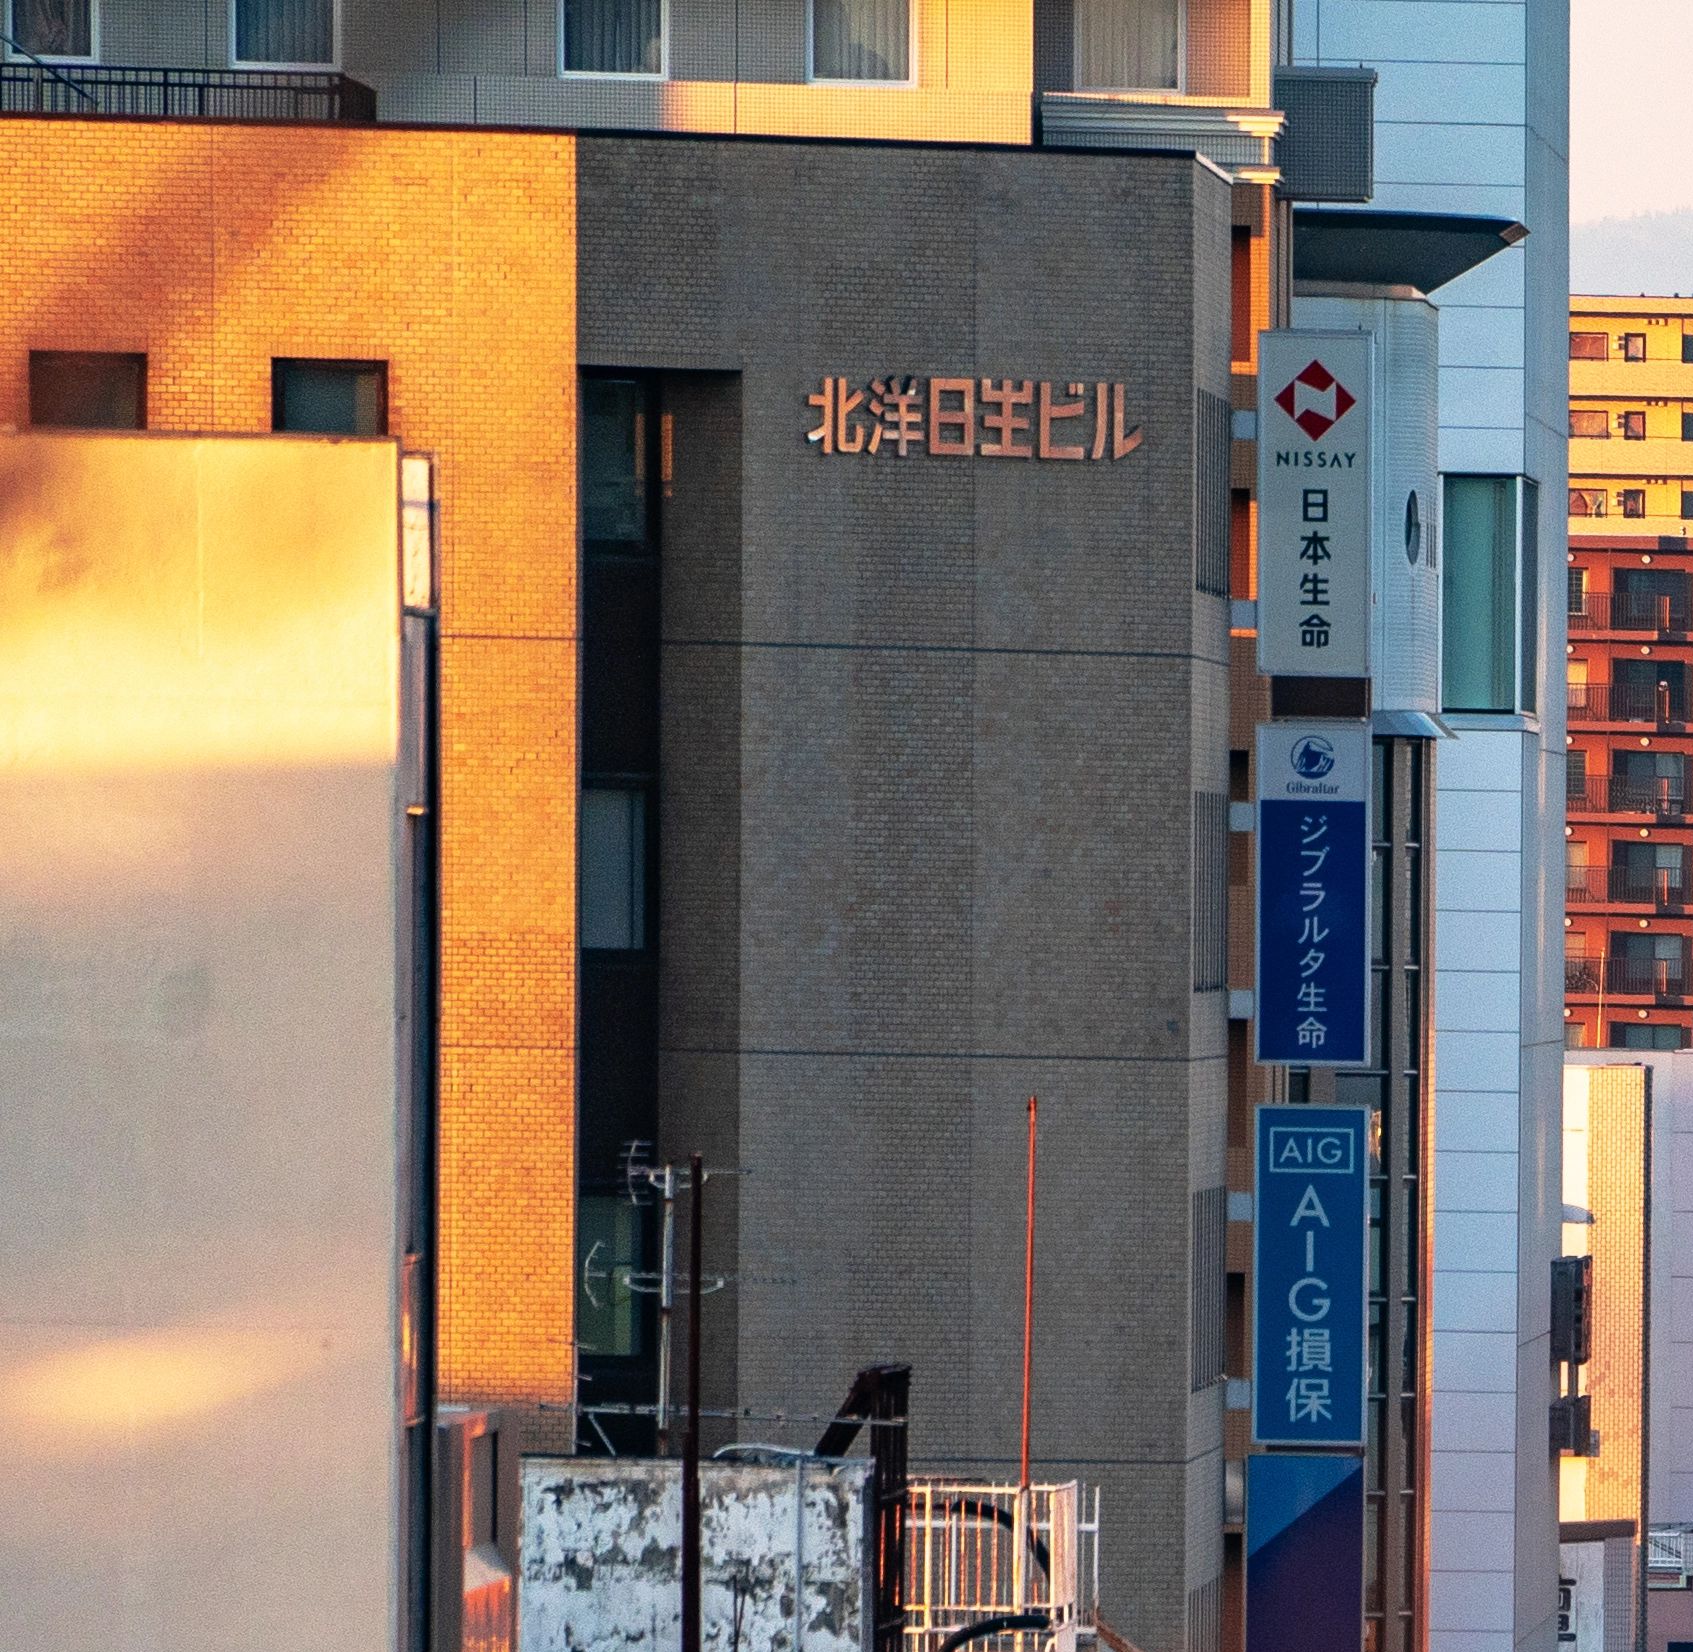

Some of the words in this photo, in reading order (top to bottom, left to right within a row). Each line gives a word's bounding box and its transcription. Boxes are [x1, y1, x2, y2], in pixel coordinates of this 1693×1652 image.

[808, 376, 1144, 461] 北洋日生ビル
[1276, 450, 1357, 469] NISSAY
[1299, 489, 1333, 650] 日本生命
[1286, 780, 1341, 796] Gibraltar
[1295, 814, 1330, 1050] ジブラルタ生命
[1279, 1137, 1343, 1165] AIG
[1285, 1184, 1334, 1424] AIG損保
